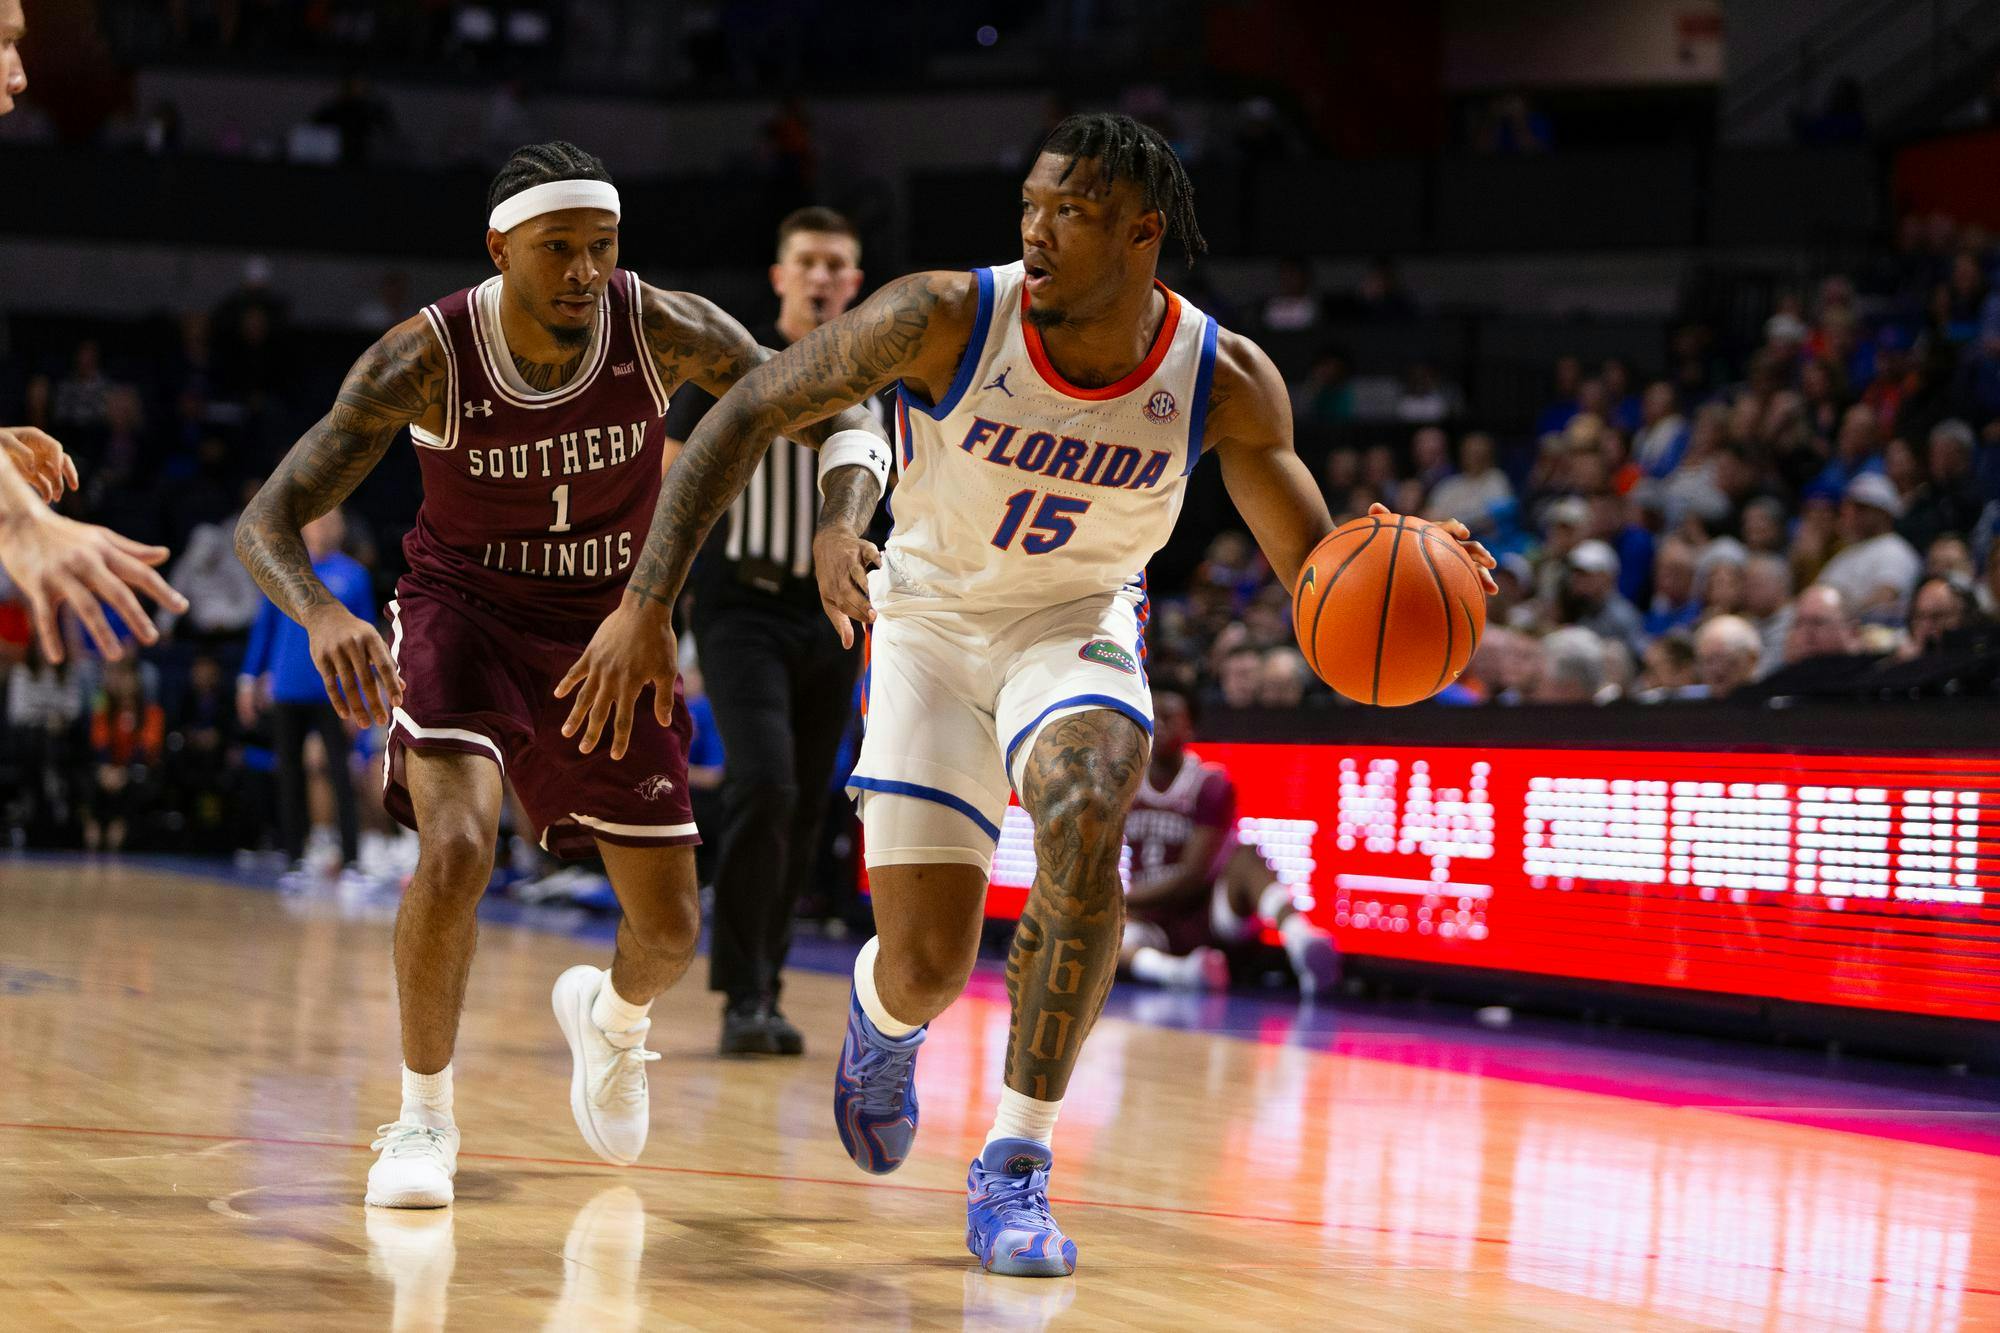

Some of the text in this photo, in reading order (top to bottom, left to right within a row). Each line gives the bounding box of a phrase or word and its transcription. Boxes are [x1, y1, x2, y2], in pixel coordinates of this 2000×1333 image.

[612, 360, 634, 376] VALLEY
[1151, 392, 1173, 416] SEC
[469, 421, 647, 478] SOUTHERN
[957, 415, 1172, 491] FLORIDA
[549, 484, 572, 532] 1
[990, 488, 1092, 555] 15
[483, 531, 632, 577] ILLINOIS
